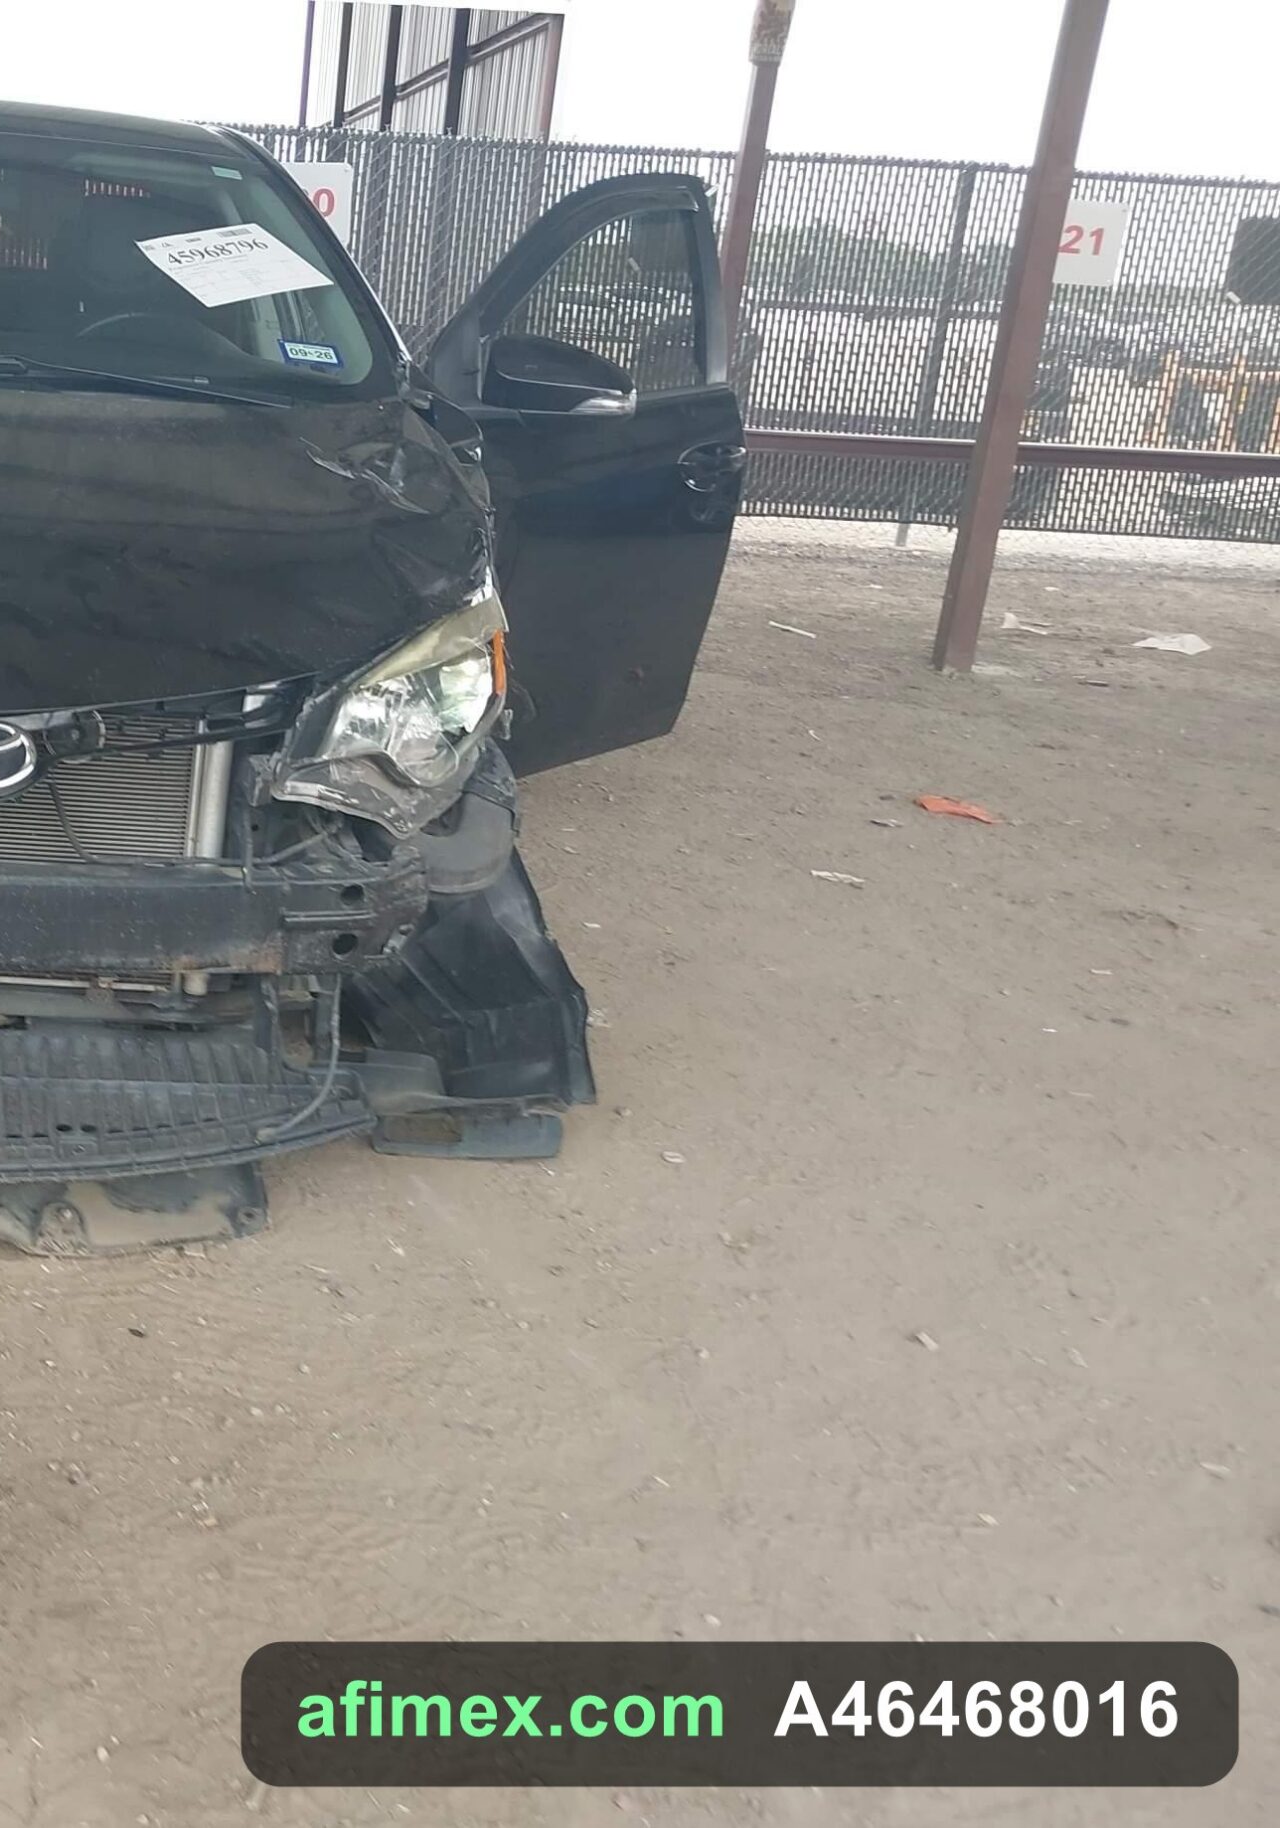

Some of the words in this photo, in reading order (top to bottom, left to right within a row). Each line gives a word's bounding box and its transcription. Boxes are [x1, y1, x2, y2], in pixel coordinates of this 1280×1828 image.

[303, 188, 335, 218] 0
[168, 238, 269, 266] 45968796
[1056, 225, 1105, 256] 21
